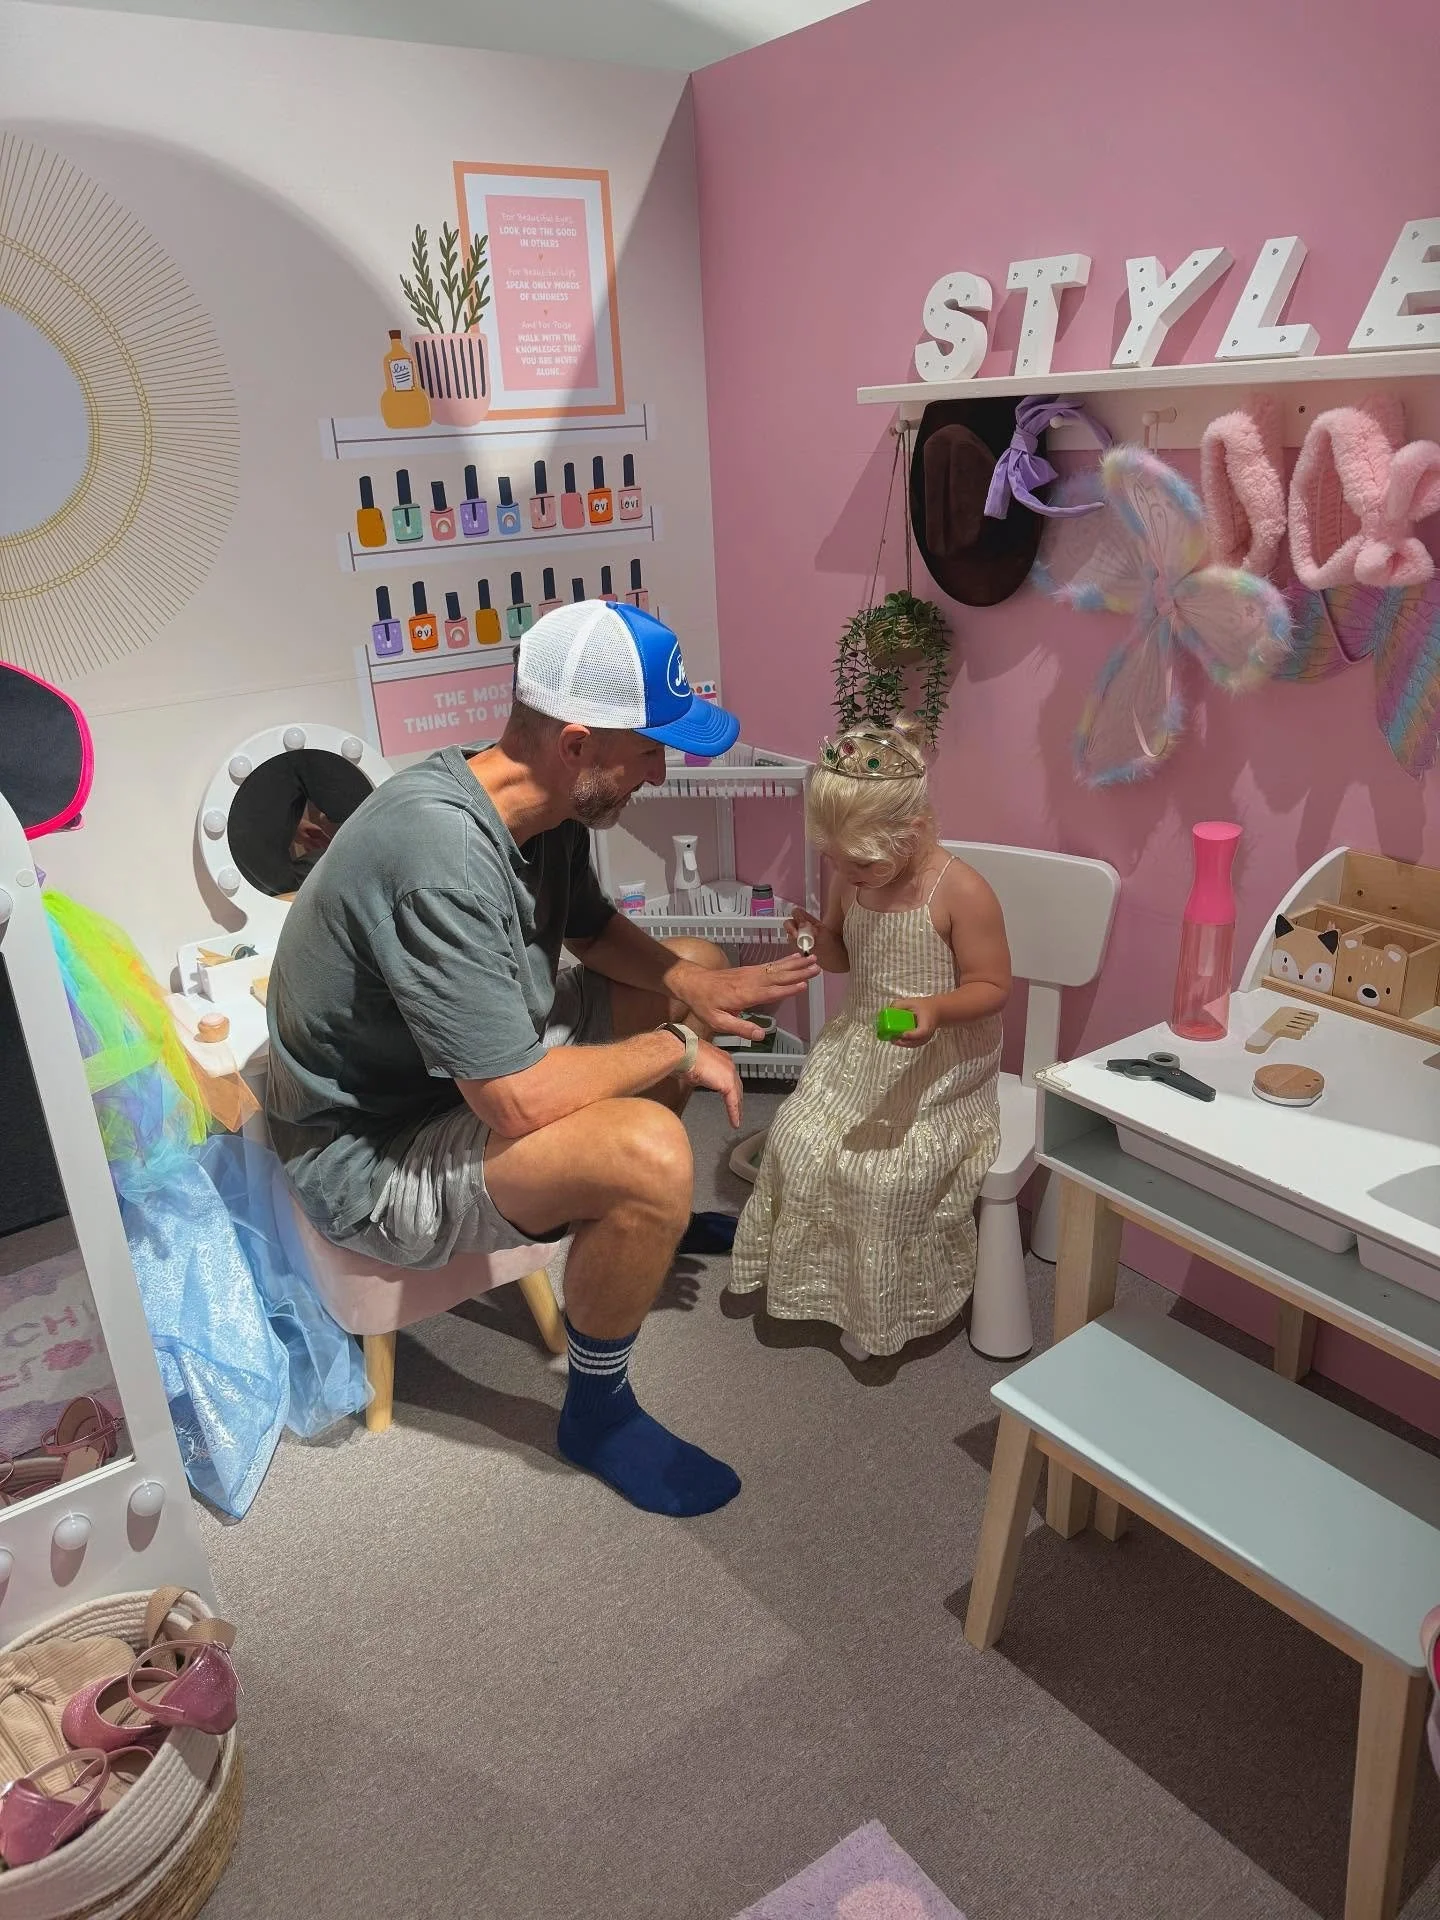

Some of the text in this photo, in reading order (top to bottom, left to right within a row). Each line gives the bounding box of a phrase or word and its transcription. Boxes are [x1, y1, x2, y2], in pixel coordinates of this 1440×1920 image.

[500, 226, 577, 237] LOOK FOR THE GOOD
[520, 239, 560, 248] IN OTHERS
[505, 280, 580, 290] SPEAK ONLY WORDS
[520, 293, 569, 301] OF KINDNESS
[915, 217, 1440, 382] STYLE
[517, 333, 577, 343] WALK WITH THE
[515, 343, 583, 354] KNOWLEDGE THAT
[521, 356, 537, 365] YOU
[433, 689, 467, 709] THE
[403, 711, 460, 734] THING
[465, 706, 487, 724] TO
